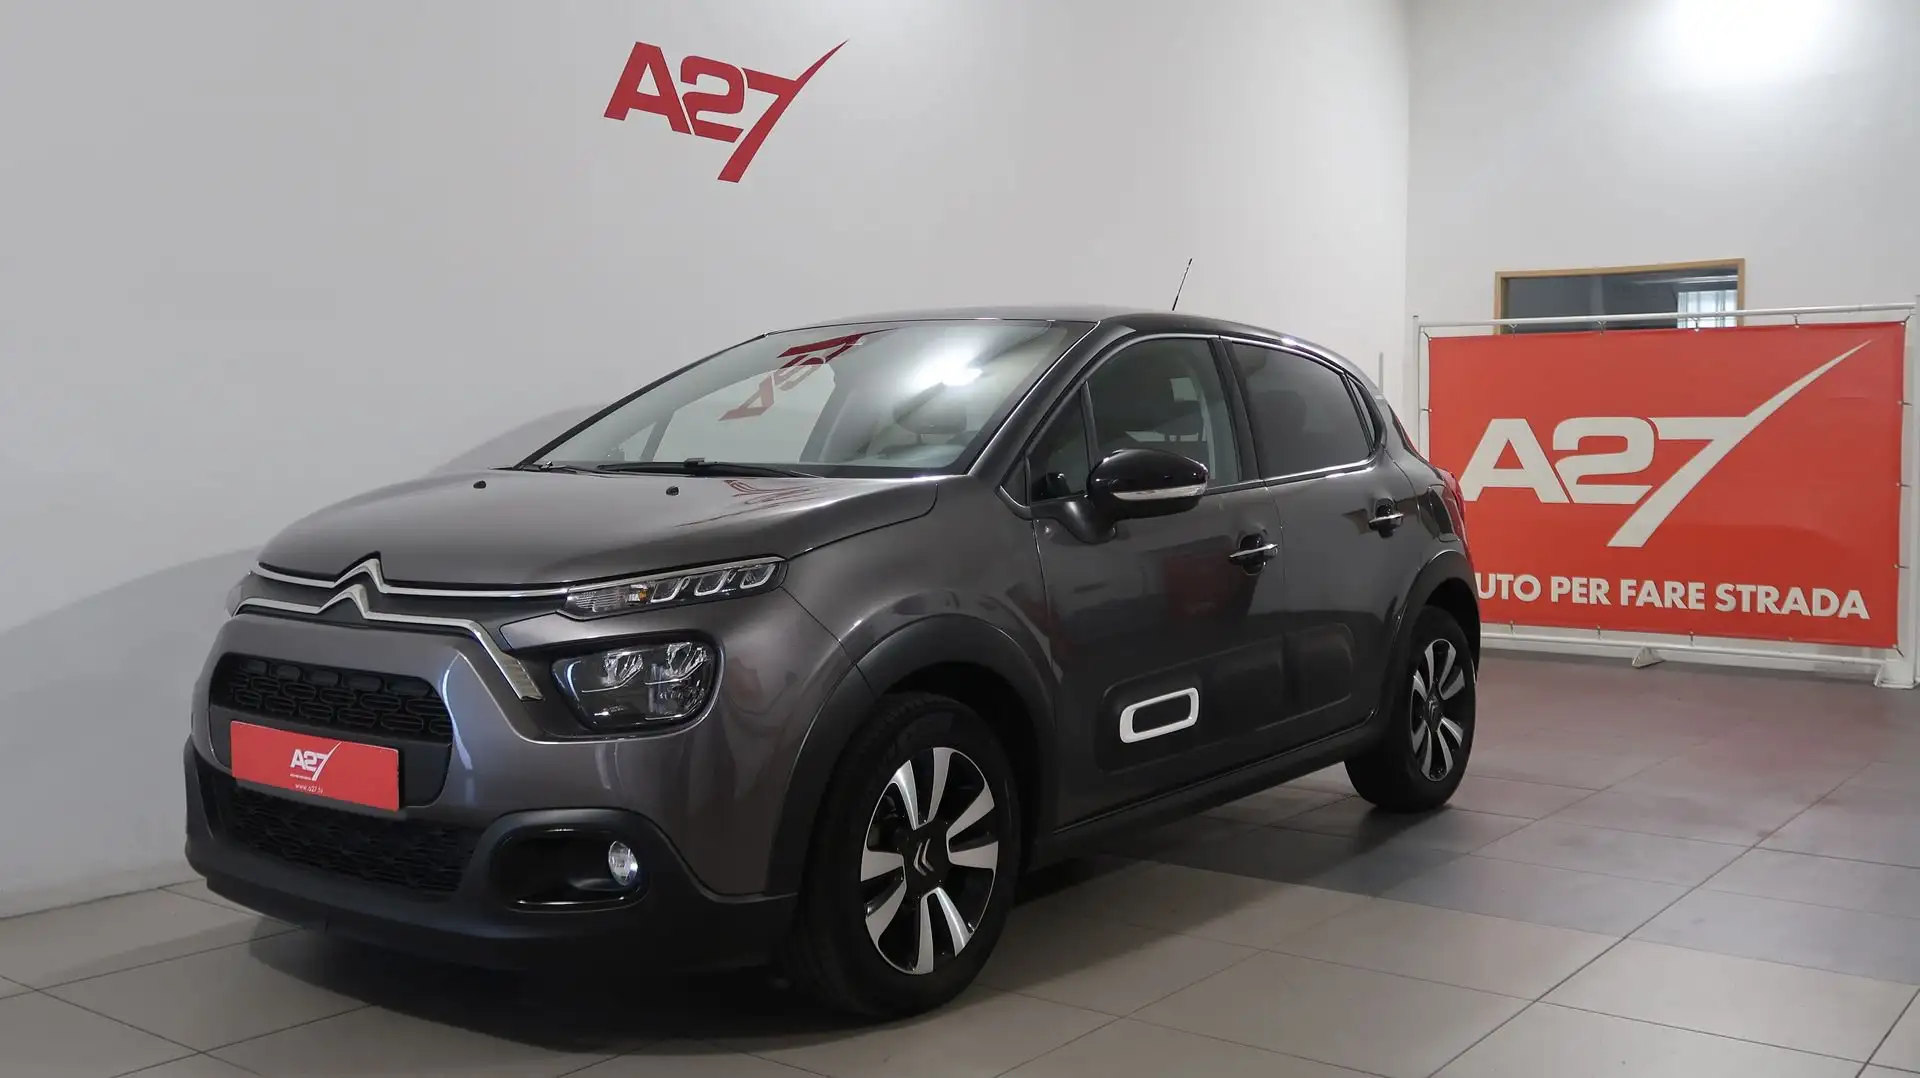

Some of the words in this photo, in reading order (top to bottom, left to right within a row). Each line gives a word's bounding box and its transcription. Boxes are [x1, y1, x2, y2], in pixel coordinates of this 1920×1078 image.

[603, 40, 849, 183] A27
[1458, 340, 1872, 547] A27
[1474, 572, 1541, 602] UTO
[1551, 575, 1612, 606] PER
[1620, 578, 1705, 610] FARE
[1714, 583, 1870, 620] STRADA
[290, 741, 342, 781] A27
